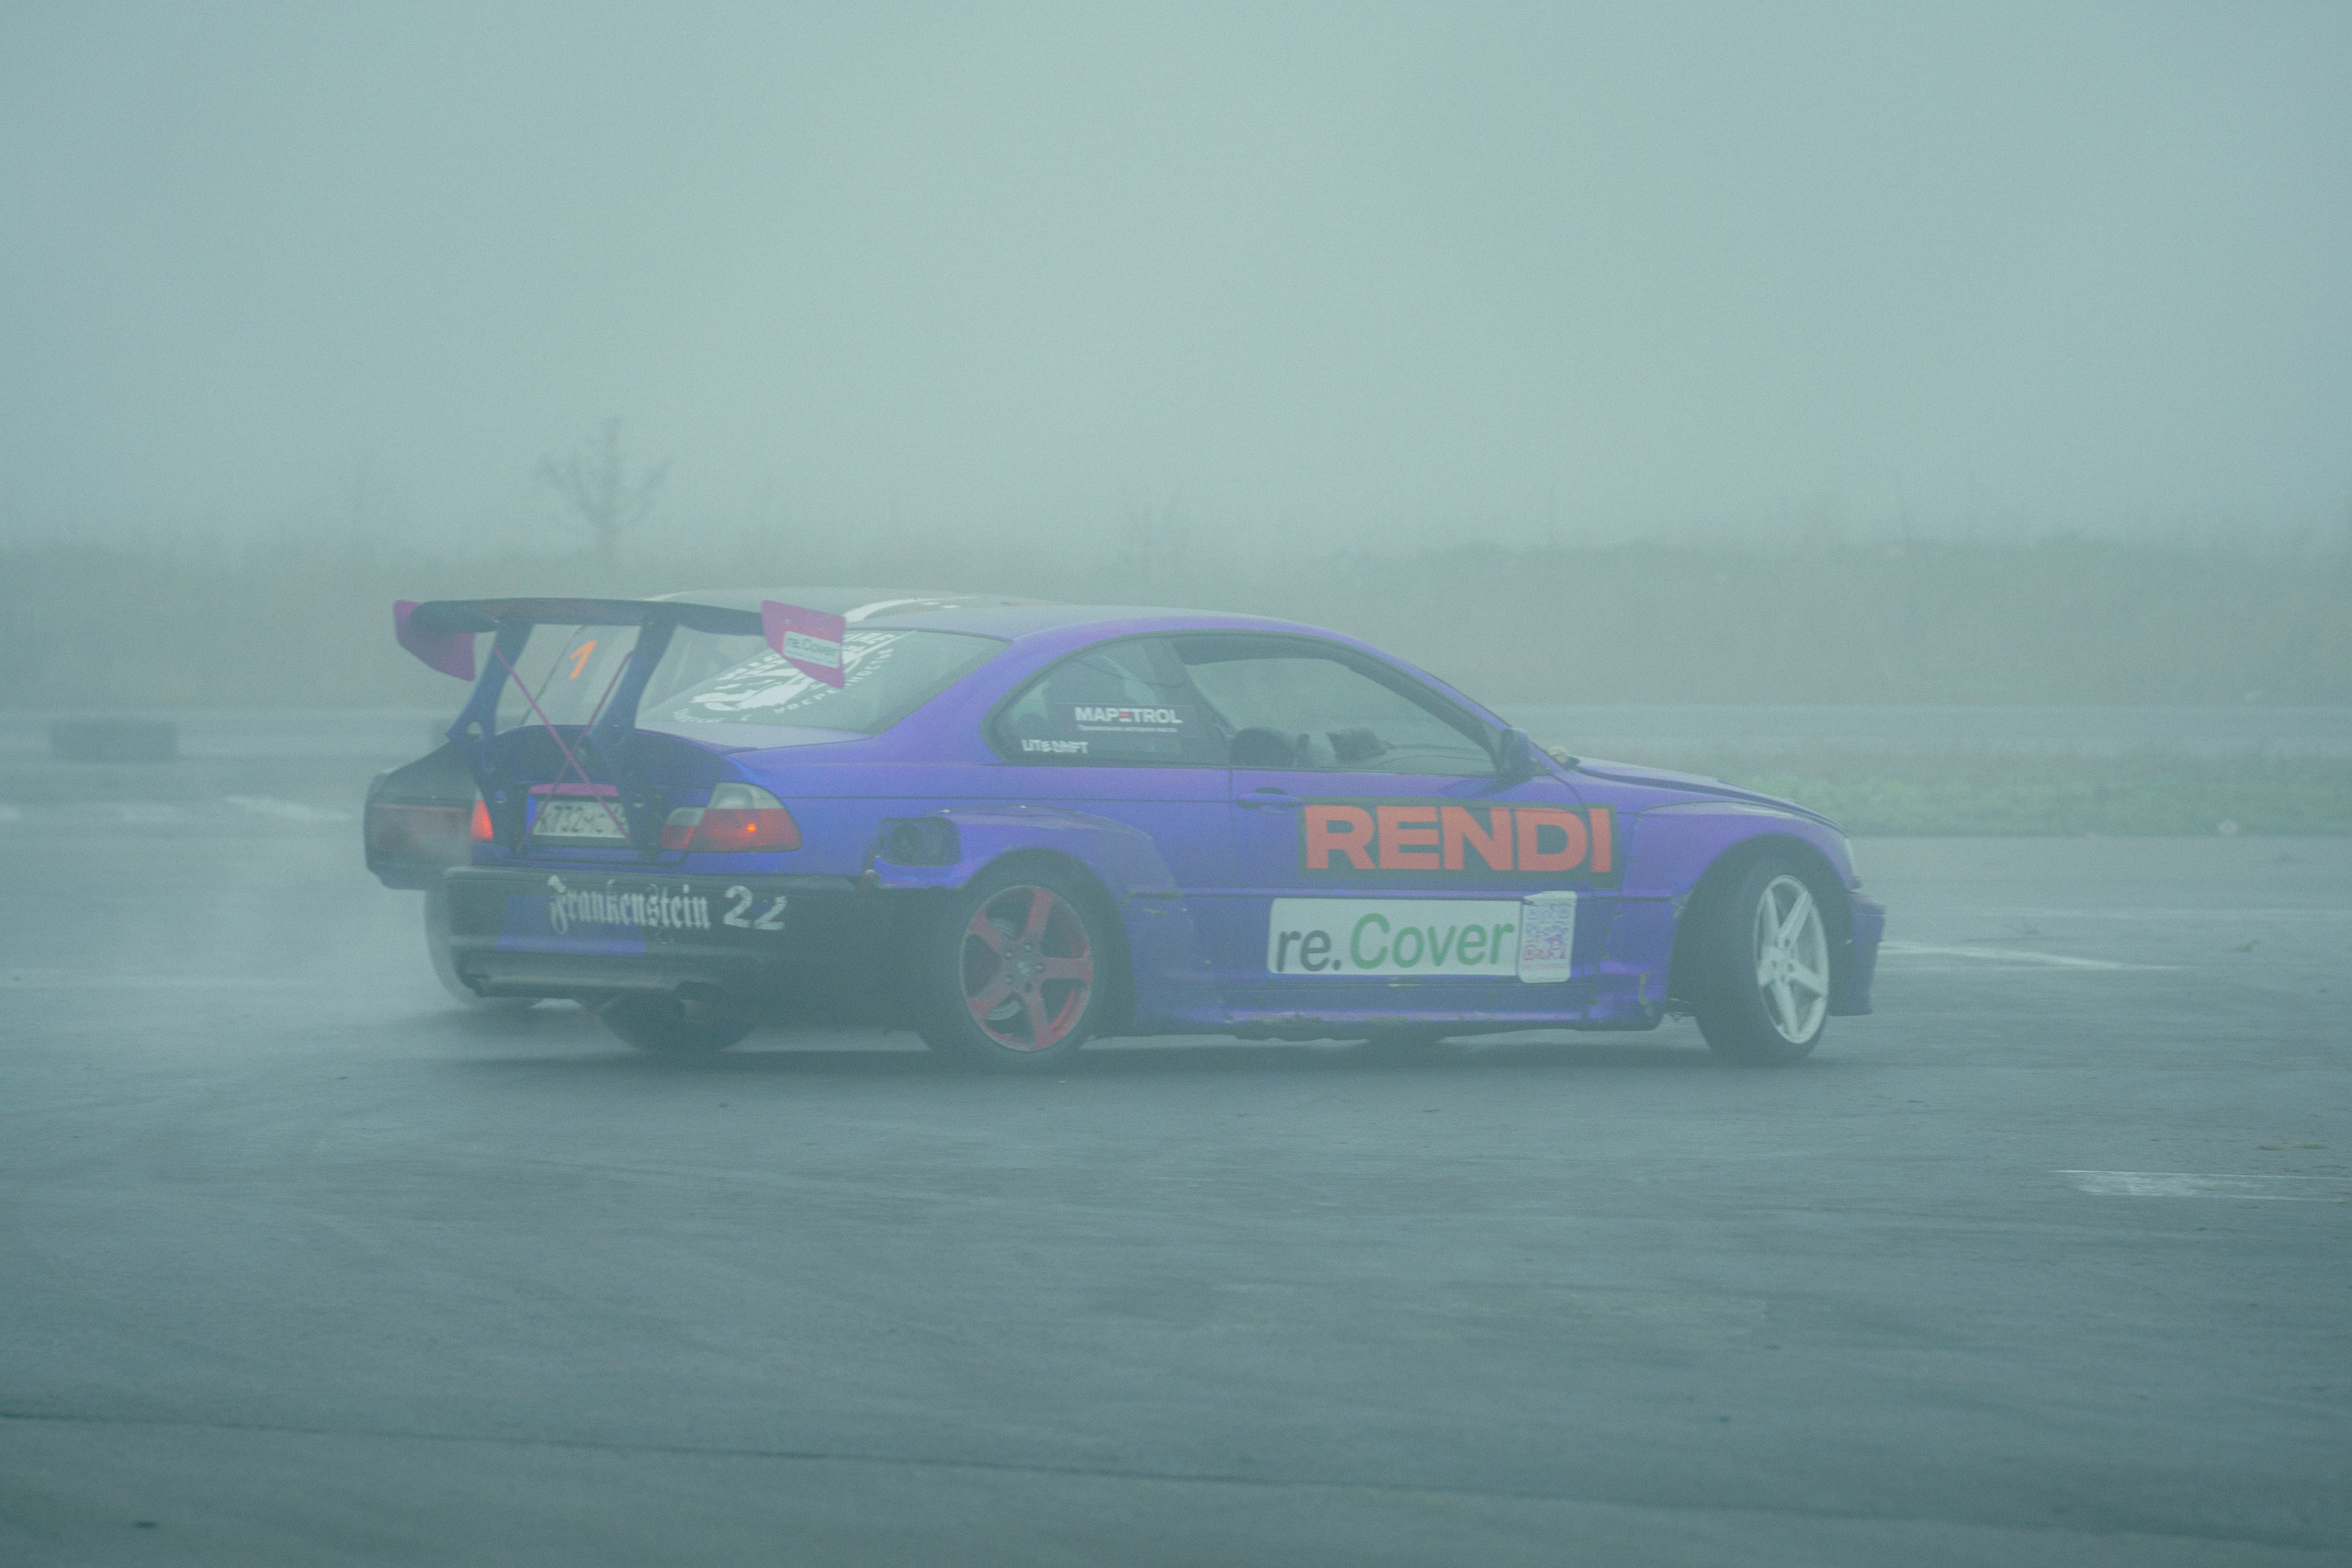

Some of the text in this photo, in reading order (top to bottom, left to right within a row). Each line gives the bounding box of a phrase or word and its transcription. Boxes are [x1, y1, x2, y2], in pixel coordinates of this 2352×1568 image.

[569, 640, 597, 680] 1
[1074, 706, 1182, 725] MAPETROL
[1304, 804, 1612, 874] RENDI
[548, 874, 788, 935] Frankenstein 22
[1276, 911, 1516, 974] re.Cover
